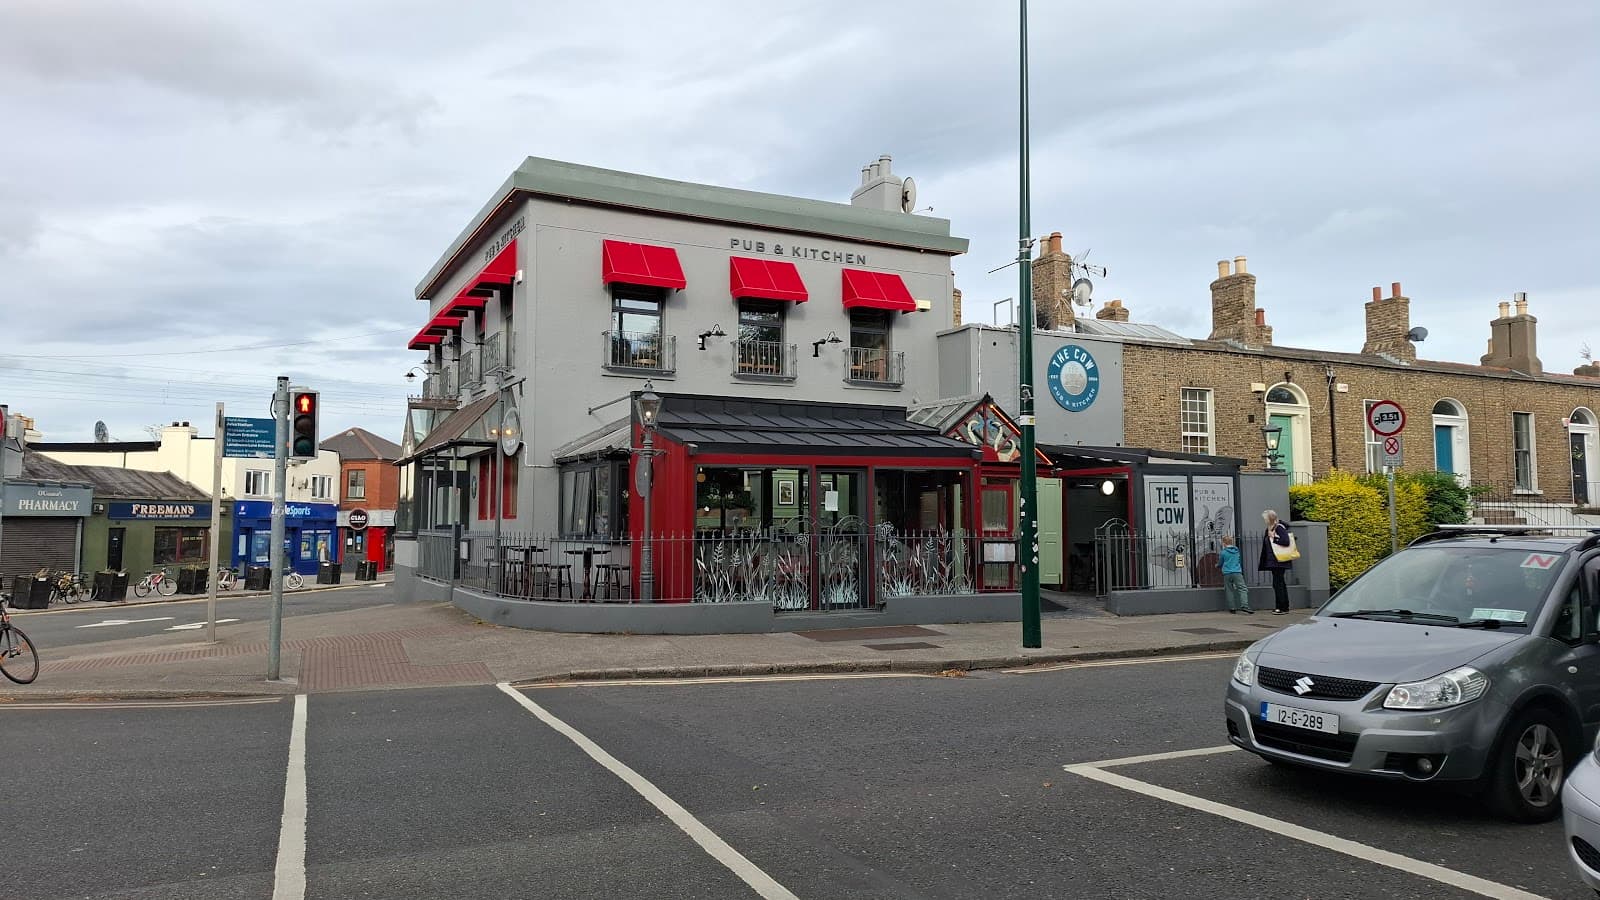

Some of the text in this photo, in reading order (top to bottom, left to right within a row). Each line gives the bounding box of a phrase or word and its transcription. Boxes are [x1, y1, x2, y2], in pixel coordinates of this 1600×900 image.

[730, 238, 866, 265] PUB & KITCHEN
[1052, 348, 1095, 370] THE COW
[1053, 386, 1064, 400] PUB
[1072, 388, 1095, 407] KITCHEN
[1156, 487, 1179, 504] THE
[18, 499, 79, 511] PHARMACY
[132, 503, 195, 515] FREEMAN'S
[1156, 507, 1184, 525] COW
[1524, 554, 1556, 568] N
[1278, 709, 1323, 730] 12-G-289
